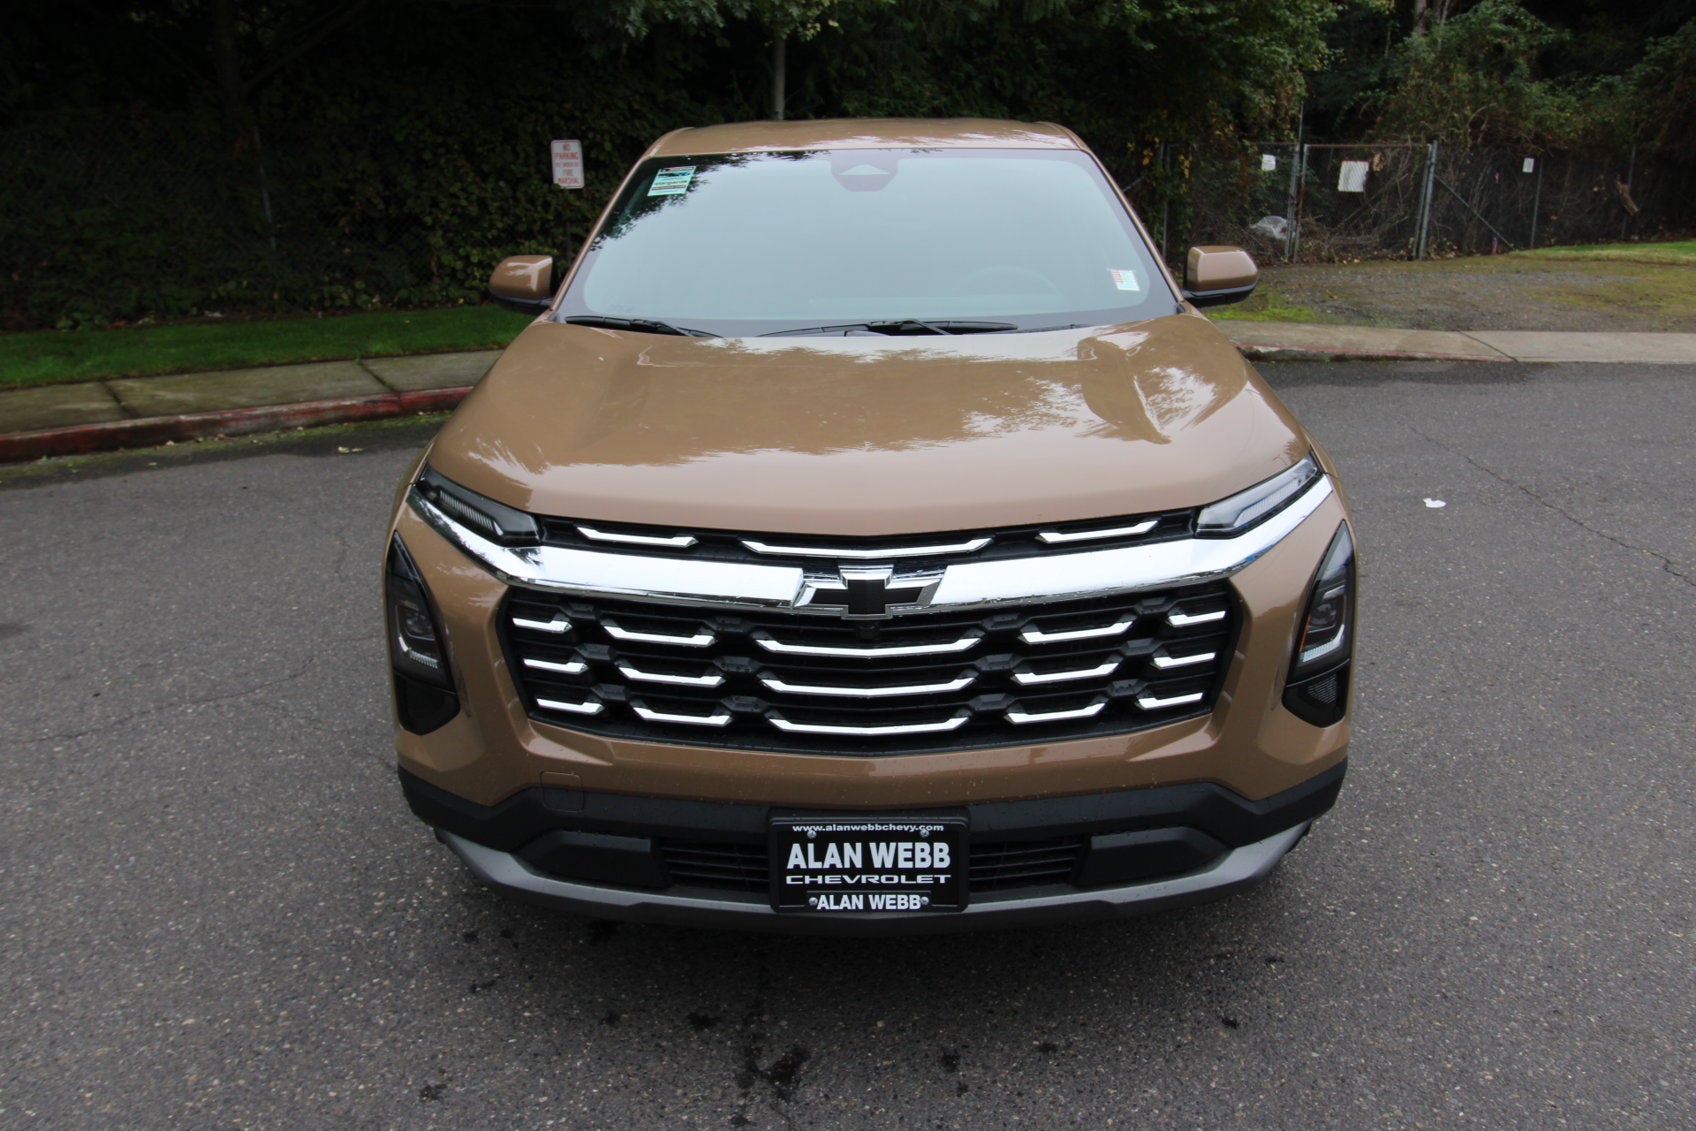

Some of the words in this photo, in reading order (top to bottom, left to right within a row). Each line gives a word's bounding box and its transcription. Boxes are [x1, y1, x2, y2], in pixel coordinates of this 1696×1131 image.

[555, 152, 579, 160] PARKING
[792, 823, 944, 832] www.alanwebbchevy.com
[786, 842, 863, 869] ALAN
[869, 842, 951, 869] WEBB
[786, 874, 951, 885] CHEVROLET
[816, 894, 864, 910] ALAN
[867, 894, 921, 910] WEBB
